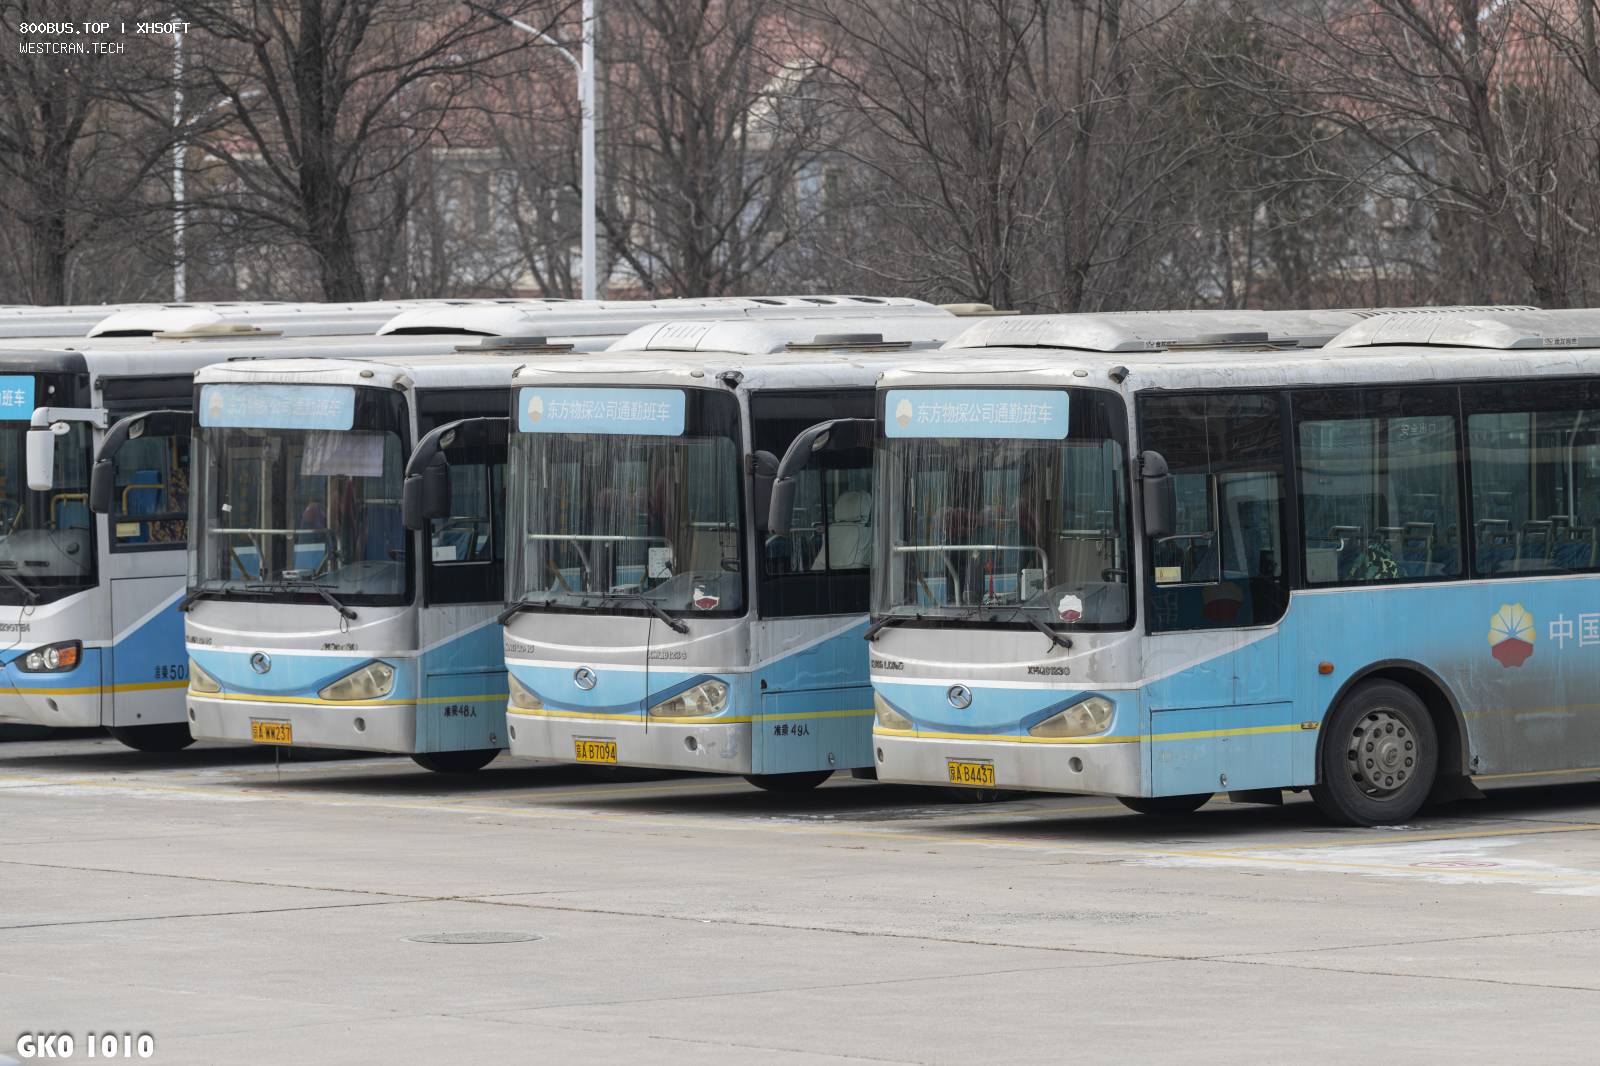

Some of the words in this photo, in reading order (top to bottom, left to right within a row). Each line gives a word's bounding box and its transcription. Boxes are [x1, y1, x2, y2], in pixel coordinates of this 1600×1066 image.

[546, 400, 671, 422] 东方物探公司通勤班车
[917, 402, 1053, 424] 东方物探公司通勤班车
[1549, 613, 1600, 650] 中国
